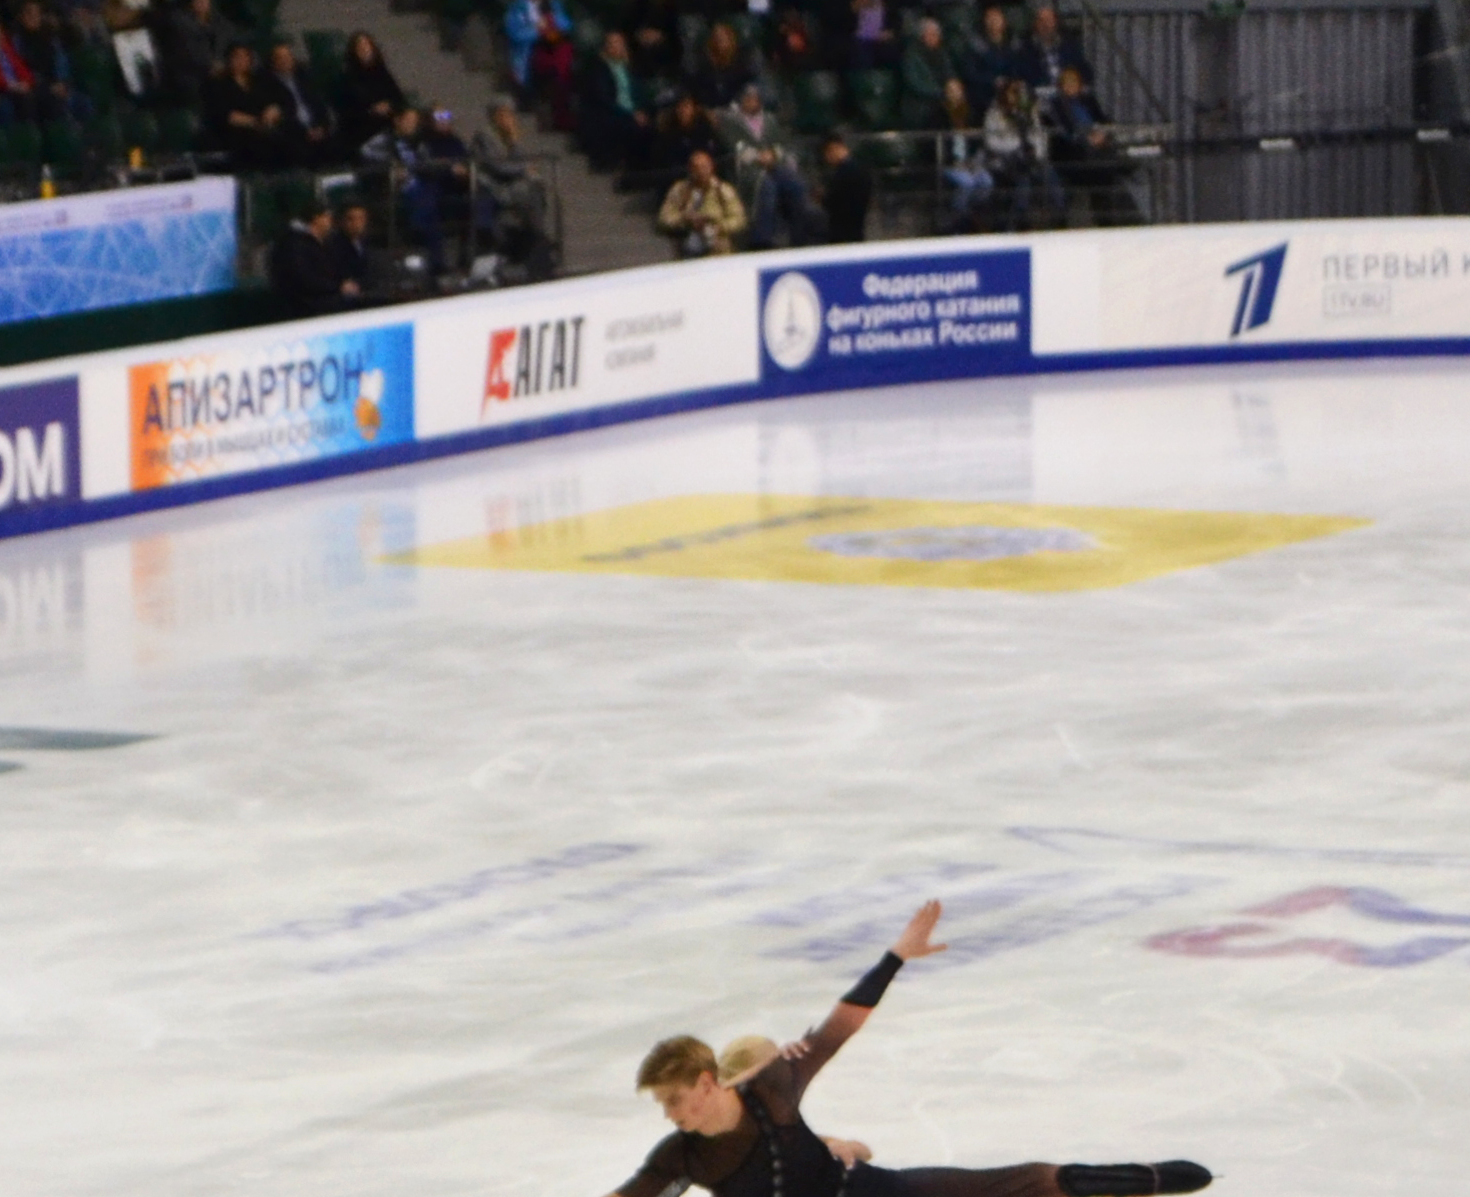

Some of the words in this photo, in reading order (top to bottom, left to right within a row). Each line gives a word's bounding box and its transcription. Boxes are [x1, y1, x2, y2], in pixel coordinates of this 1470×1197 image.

[1322, 250, 1450, 280] ПЕРВЫЙ
[862, 270, 979, 299] Федерация
[826, 301, 931, 332] фигурного
[935, 294, 1021, 321] катания
[828, 334, 852, 354] на
[855, 327, 934, 352] коньках
[939, 320, 1018, 346] России
[513, 315, 585, 398] АГАТ
[143, 352, 363, 434] АПИЗАРТРОН
